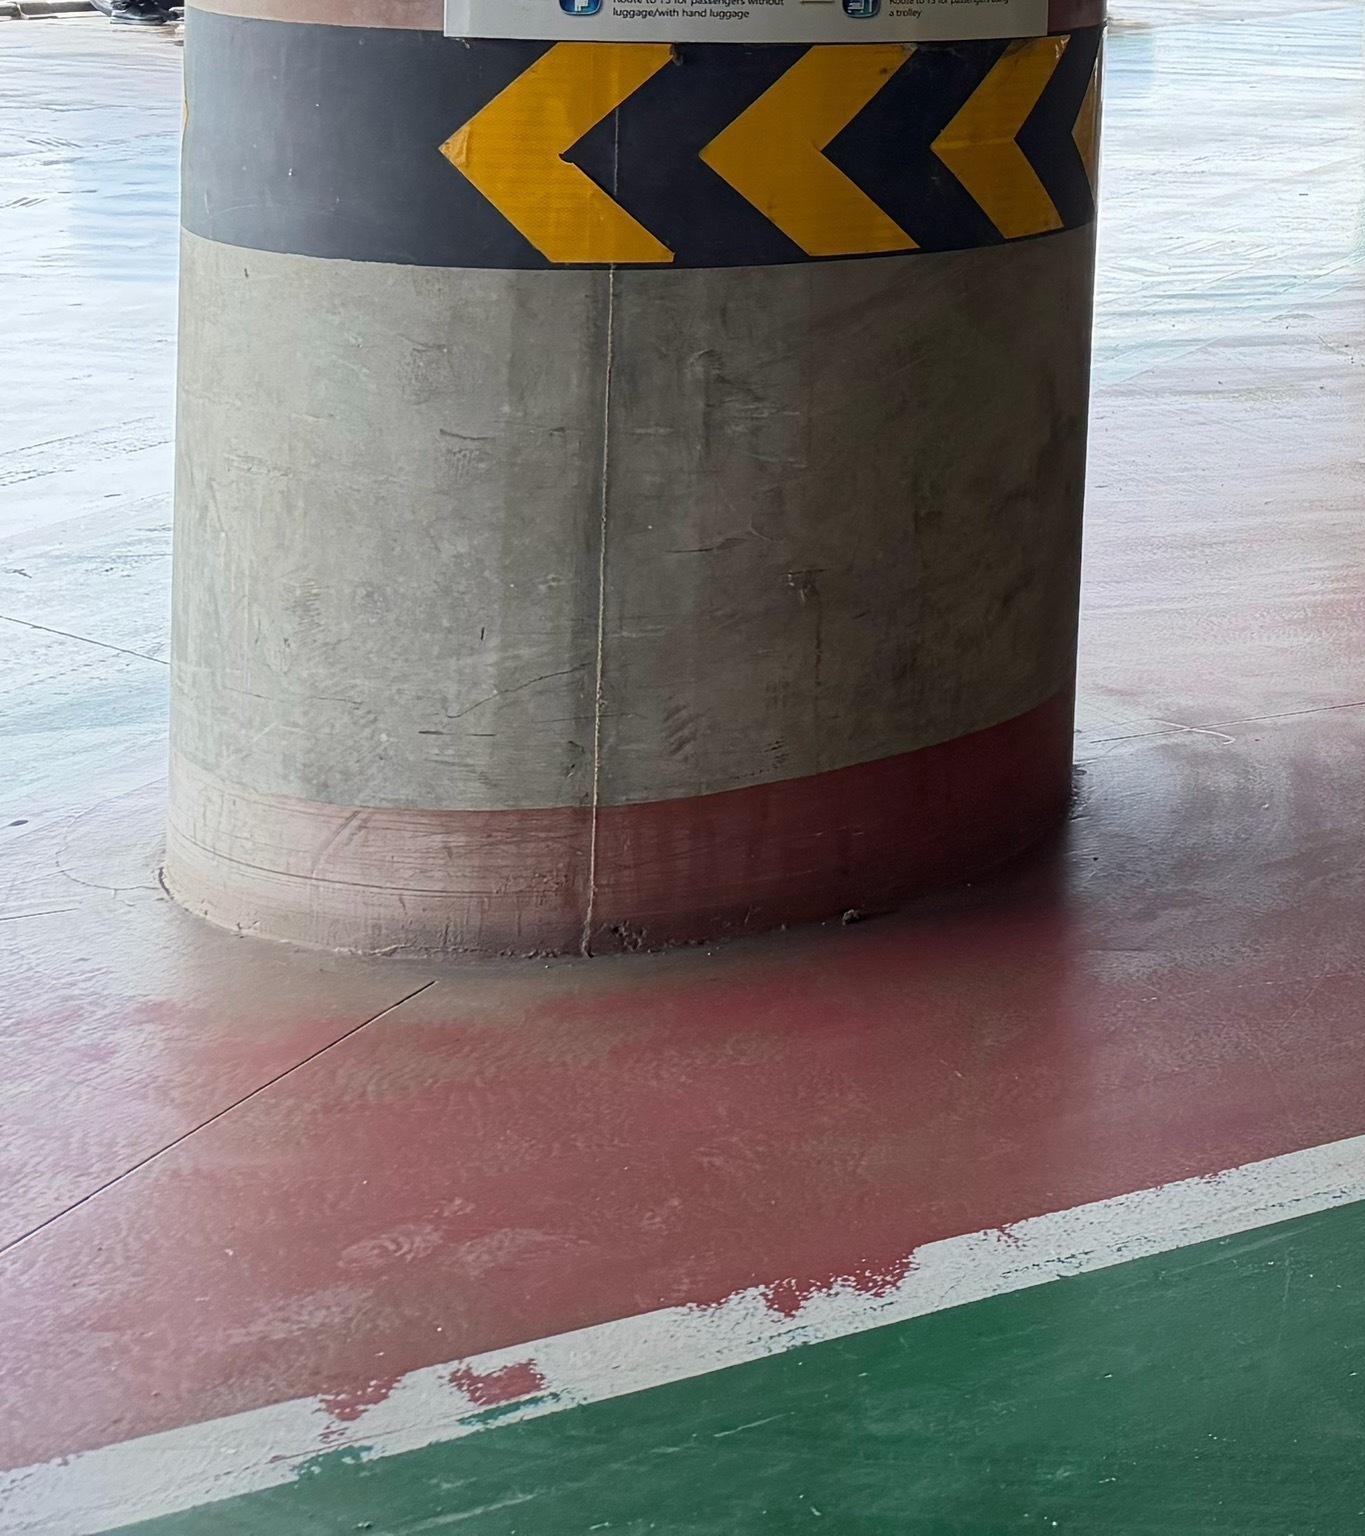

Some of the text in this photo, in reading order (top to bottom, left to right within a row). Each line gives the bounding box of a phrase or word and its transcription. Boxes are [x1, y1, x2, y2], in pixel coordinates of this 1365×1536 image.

[612, 7, 750, 20] luggage/with hand luggage
[896, 9, 923, 19] trolley
